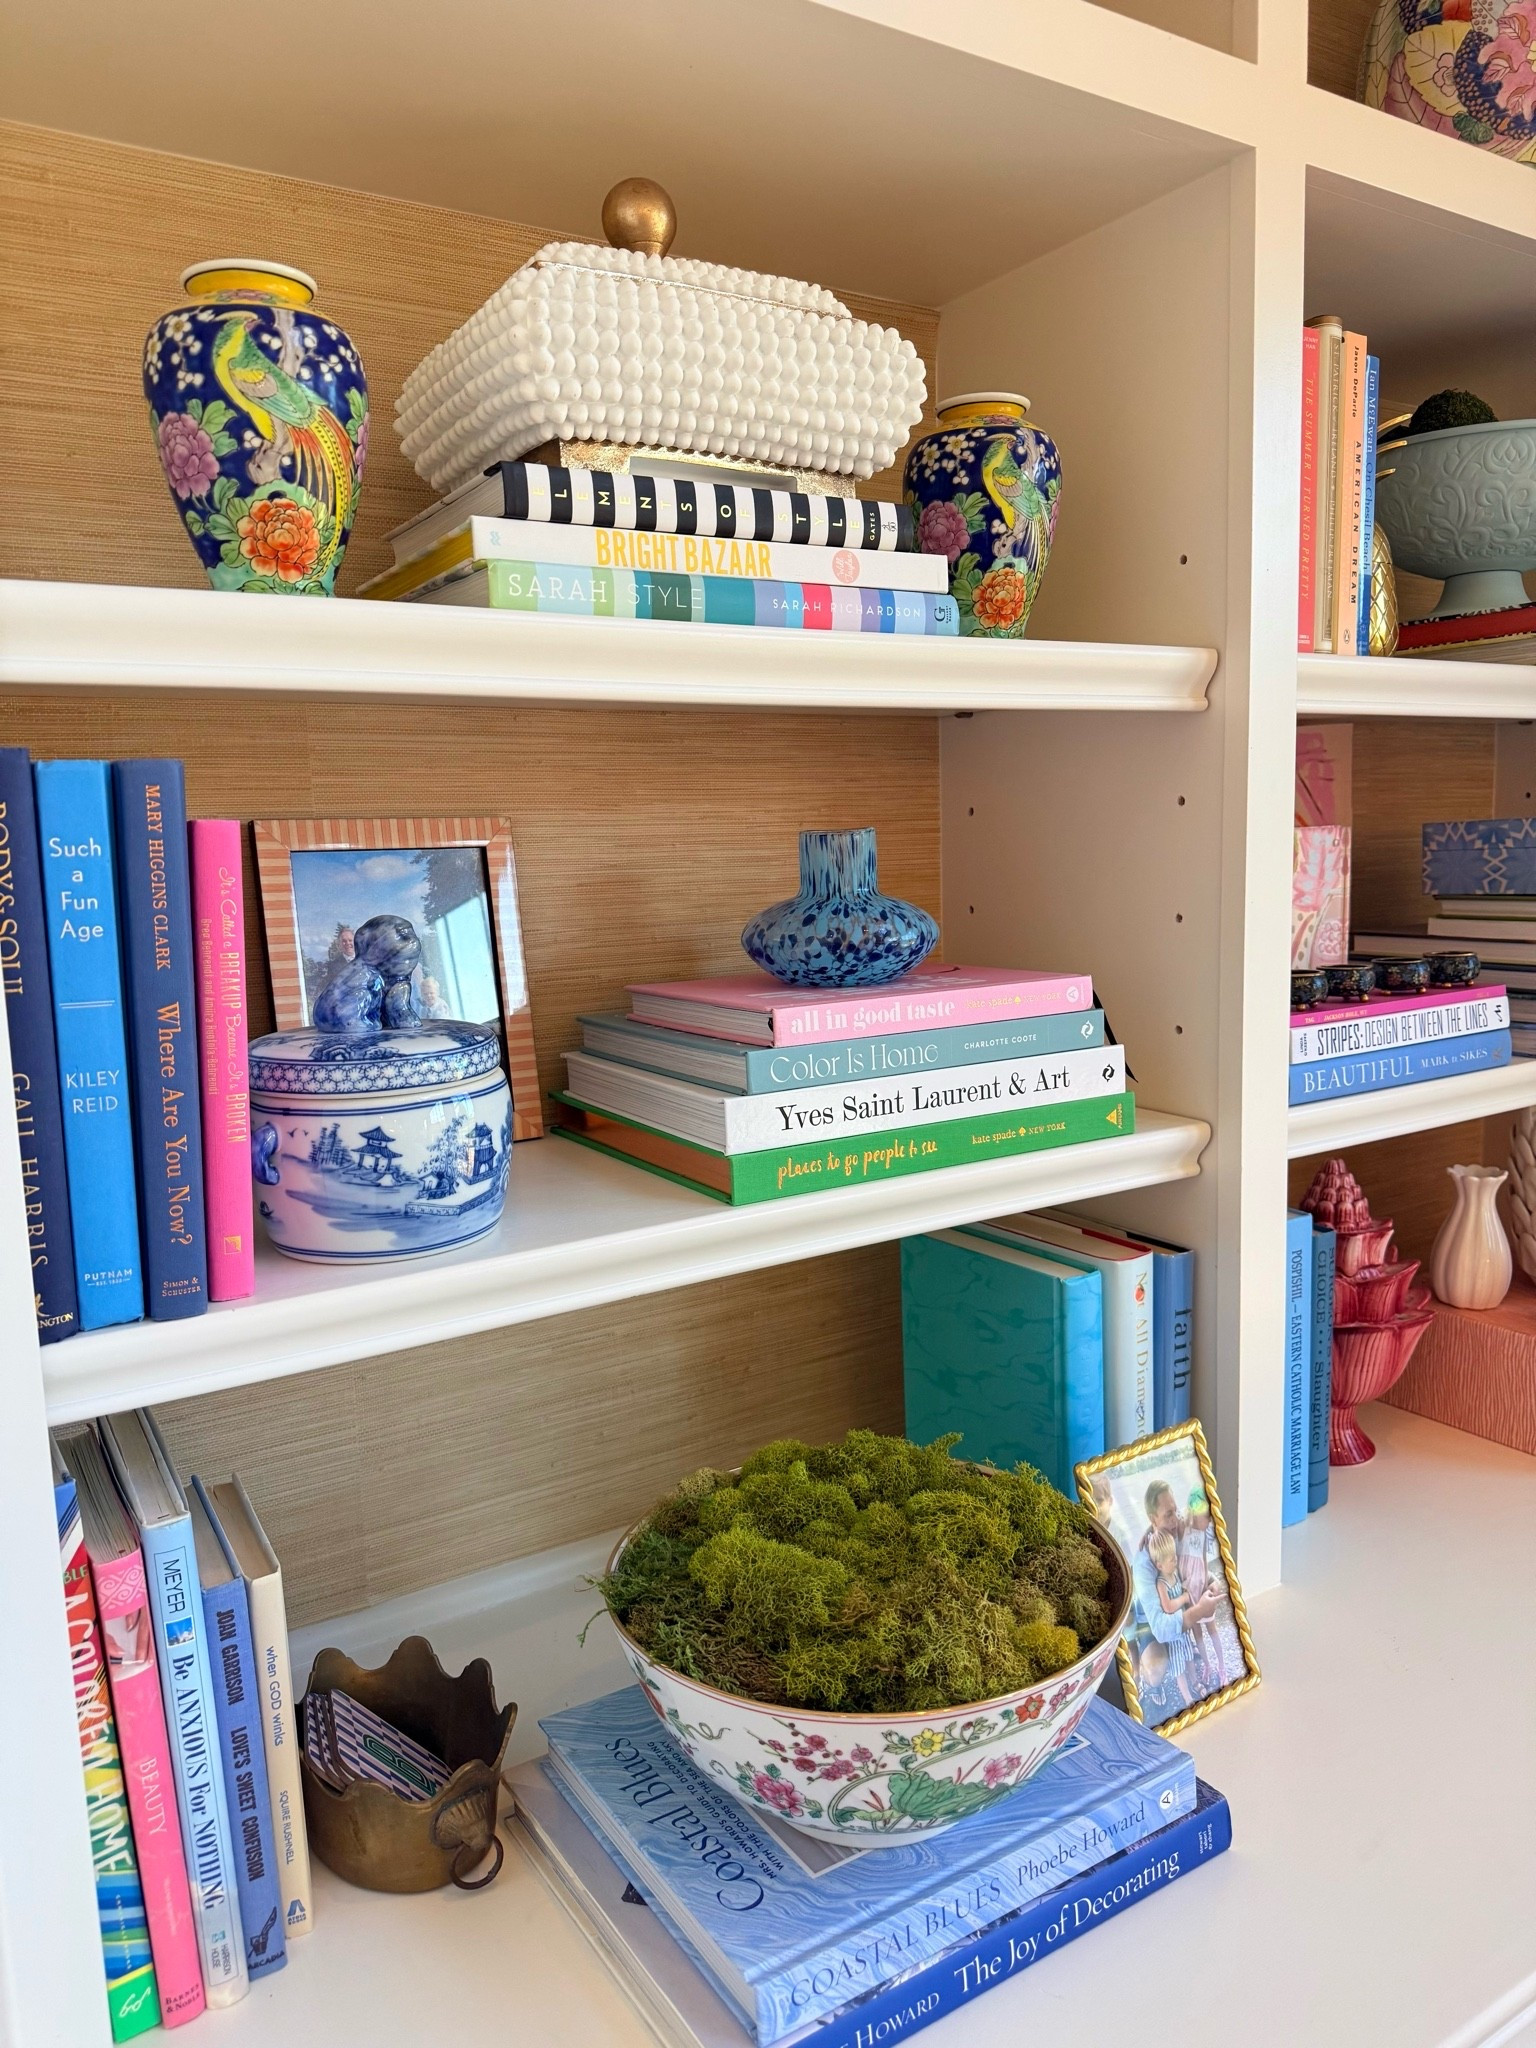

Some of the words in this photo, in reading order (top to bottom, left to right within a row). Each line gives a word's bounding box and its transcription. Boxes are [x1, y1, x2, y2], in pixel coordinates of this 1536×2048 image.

[1304, 411, 1313, 469] SUMMER
[1353, 441, 1361, 532] AMERICAN
[1365, 462, 1373, 482] On
[532, 487, 693, 512] ELEMENTS
[720, 507, 751, 518] OF
[777, 512, 860, 529] STYLE
[1303, 487, 1311, 542] TURNED
[1364, 487, 1372, 528] Chesil
[595, 529, 678, 571] BRIGHT
[684, 537, 773, 578] BAZAAR
[1362, 529, 1371, 571] Beach
[508, 573, 607, 603] SARAH
[627, 583, 703, 609] STYLE
[1301, 547, 1311, 600] PRETTY
[1350, 546, 1358, 604] DREAM
[773, 598, 821, 612] SARAH
[830, 603, 921, 618] RICHARDSON
[145, 784, 163, 833] MARY
[49, 838, 102, 858] Such
[72, 870, 83, 883] a
[148, 839, 168, 909] HIGGINS
[61, 891, 98, 912] Fun
[220, 899, 238, 938] Called
[60, 920, 104, 942] Age
[153, 914, 171, 970] CLARK
[220, 952, 242, 1009] BREAKUP
[226, 1013, 242, 1059] Because
[790, 1010, 819, 1034] all
[826, 1009, 847, 1030] in
[853, 1001, 901, 1031] good
[907, 1000, 955, 1021] taste
[1317, 1024, 1363, 1056] STRIPES:
[1365, 1017, 1398, 1048] DESIGN
[1401, 1010, 1443, 1042] BETWEEN
[1445, 1007, 1461, 1034] THE
[1464, 1003, 1488, 1031] LINES
[156, 1001, 181, 1079] Where
[964, 1037, 1008, 1050] CHARLOTTE
[1012, 1034, 1037, 1044] COOTE
[66, 1069, 120, 1089] KILEY
[769, 1051, 840, 1084] Color
[846, 1047, 865, 1074] Is
[871, 1042, 938, 1071] Home
[1303, 1055, 1413, 1093] BEAUTIFUL
[1421, 1056, 1449, 1068] MARK
[1459, 1048, 1488, 1061] SIKES
[73, 1095, 118, 1114] REID
[162, 1086, 185, 1128] Are
[226, 1093, 248, 1143] BROKEN
[775, 1104, 834, 1131] Yves
[843, 1092, 904, 1121] Saint
[912, 1078, 1002, 1111] Laurent
[1008, 1072, 1026, 1095] &
[1033, 1066, 1071, 1092] Art
[972, 1134, 990, 1145] kate
[992, 1130, 1016, 1143] spade
[1028, 1126, 1044, 1135] NEW
[1046, 1121, 1066, 1132] YORK
[164, 1133, 187, 1179] You
[777, 1158, 822, 1189] places
[827, 1152, 840, 1170] to
[845, 1154, 858, 1176] go
[863, 1139, 905, 1176] people
[909, 1140, 917, 1158] to
[167, 1184, 193, 1245] Now?
[84, 1268, 132, 1281] PUTNAM
[1291, 1249, 1303, 1302] POSPISHIL
[1316, 1251, 1328, 1324] CHOICE
[1136, 1318, 1149, 1344] All
[1291, 1315, 1302, 1362] EASTERN
[1290, 1363, 1302, 1416] CATHOLIC
[1311, 1362, 1324, 1451] Slaughter
[1290, 1416, 1302, 1472] MARRIAGE
[1290, 1473, 1301, 1495] LAW
[163, 1558, 186, 1614] MEYER
[216, 1608, 237, 1642] JOAN
[172, 1653, 194, 1681] Be
[221, 1643, 244, 1706] GARRISON
[266, 1646, 277, 1678] when
[269, 1681, 282, 1710] GOD
[176, 1688, 207, 1779] ANXIOUS
[231, 1726, 251, 1769] LOVE'S
[272, 1713, 284, 1747] winks
[660, 1740, 675, 1753] SKY
[604, 1737, 675, 1809] Blues
[647, 1742, 688, 1785] DECORATING
[672, 1753, 688, 1766] AND
[686, 1768, 700, 1780] SEA
[139, 1757, 167, 1836] BEAUTY
[189, 1781, 211, 1819] For
[236, 1771, 256, 1812] SWEET
[279, 1790, 291, 1821] SQUIRE
[686, 1785, 698, 1796] TO
[696, 1796, 720, 1819] GUIDE
[698, 1780, 713, 1795] THE
[711, 1796, 723, 1804] OF
[86, 1777, 133, 1882] HOME
[718, 1819, 759, 1860] HOWARD'S
[720, 1805, 750, 1832] COLORS
[241, 1816, 265, 1882] CONFUSION
[283, 1822, 294, 1865] RUSHNELL
[649, 1805, 765, 1912] Coastal
[747, 1833, 764, 1849] THE
[762, 1848, 785, 1871] WITH
[193, 1818, 225, 1910] NOTHING
[758, 1859, 777, 1880] MRS.
[791, 1924, 918, 2007] COASTAL
[925, 1876, 1000, 1937] BLUES
[1016, 1840, 1078, 1889] Phoebe
[1081, 1801, 1145, 1853] Howard
[211, 1947, 221, 1969] HOUSE
[221, 1943, 232, 1975] HARRISON
[247, 1950, 285, 1970] ARCADIA
[855, 1992, 940, 2048] HOWARD
[953, 1954, 1002, 1993] The
[1006, 1931, 1042, 1970] Joy
[1045, 1914, 1068, 1943] of
[1072, 1851, 1181, 1925] Decorating
